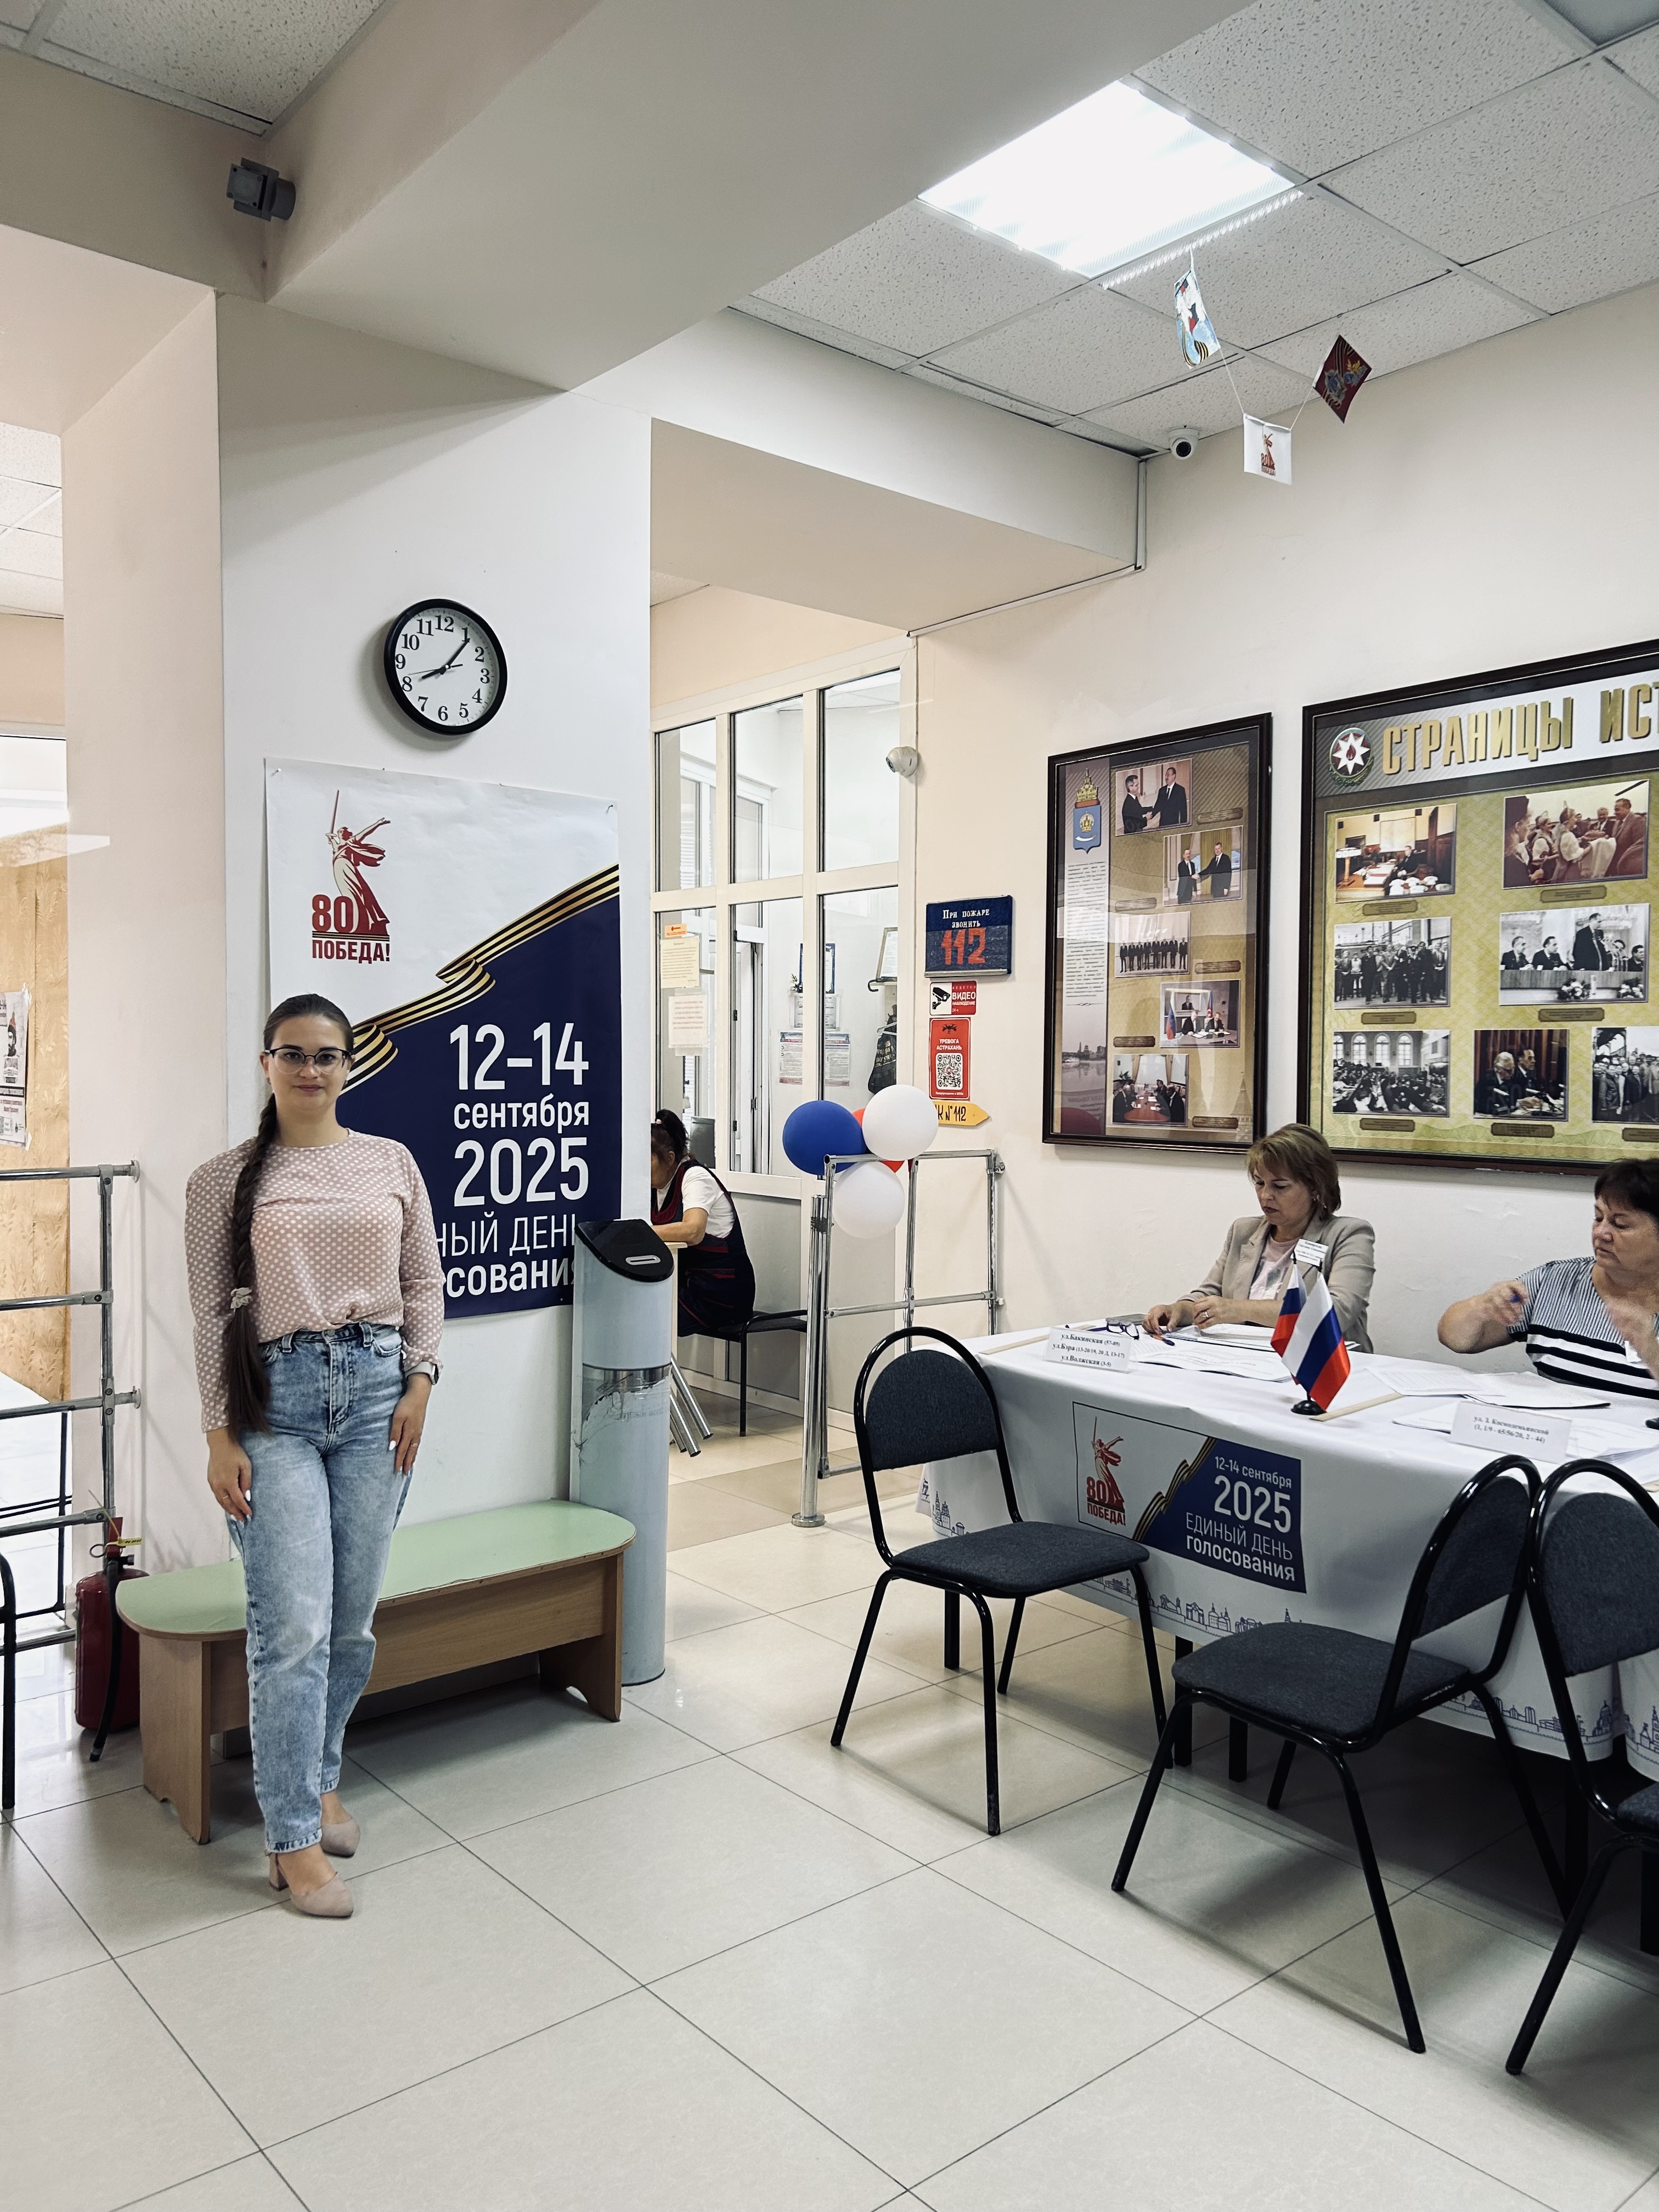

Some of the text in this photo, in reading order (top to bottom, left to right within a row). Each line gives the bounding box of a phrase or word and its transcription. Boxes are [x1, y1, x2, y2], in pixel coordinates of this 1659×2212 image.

[416, 618, 434, 636] 11
[435, 615, 454, 633] 12
[461, 627, 470, 642] 1
[402, 634, 420, 650] 10
[475, 646, 484, 662] 2
[395, 653, 406, 669] 9
[402, 676, 413, 692] 8
[480, 668, 490, 684] 3
[417, 696, 428, 712] 7
[472, 689, 482, 703] 4
[438, 706, 448, 721] 6
[459, 702, 469, 718] 5
[1382, 697, 1573, 775] СТРАНИЦЫ
[312, 894, 354, 933] 80
[312, 940, 391, 964] ПОБЕДА!
[941, 927, 986, 965] 112
[952, 991, 975, 1001] ВИДЕО
[450, 1022, 589, 1090] 12-14
[454, 1093, 589, 1134] сентября
[454, 1137, 589, 1207] 2025
[509, 1214, 575, 1256] ДЕН
[446, 1257, 575, 1297] совани
[1214, 1456, 1291, 1489] 12-14 сентября
[1086, 1476, 1107, 1504] 80
[1087, 1502, 1126, 1526] ПОБЕДА!
[1214, 1475, 1291, 1533] 2025
[1186, 1511, 1293, 1561] ЕДИНЫЙ ДЕНЬ
[1186, 1534, 1295, 1582] голосования
